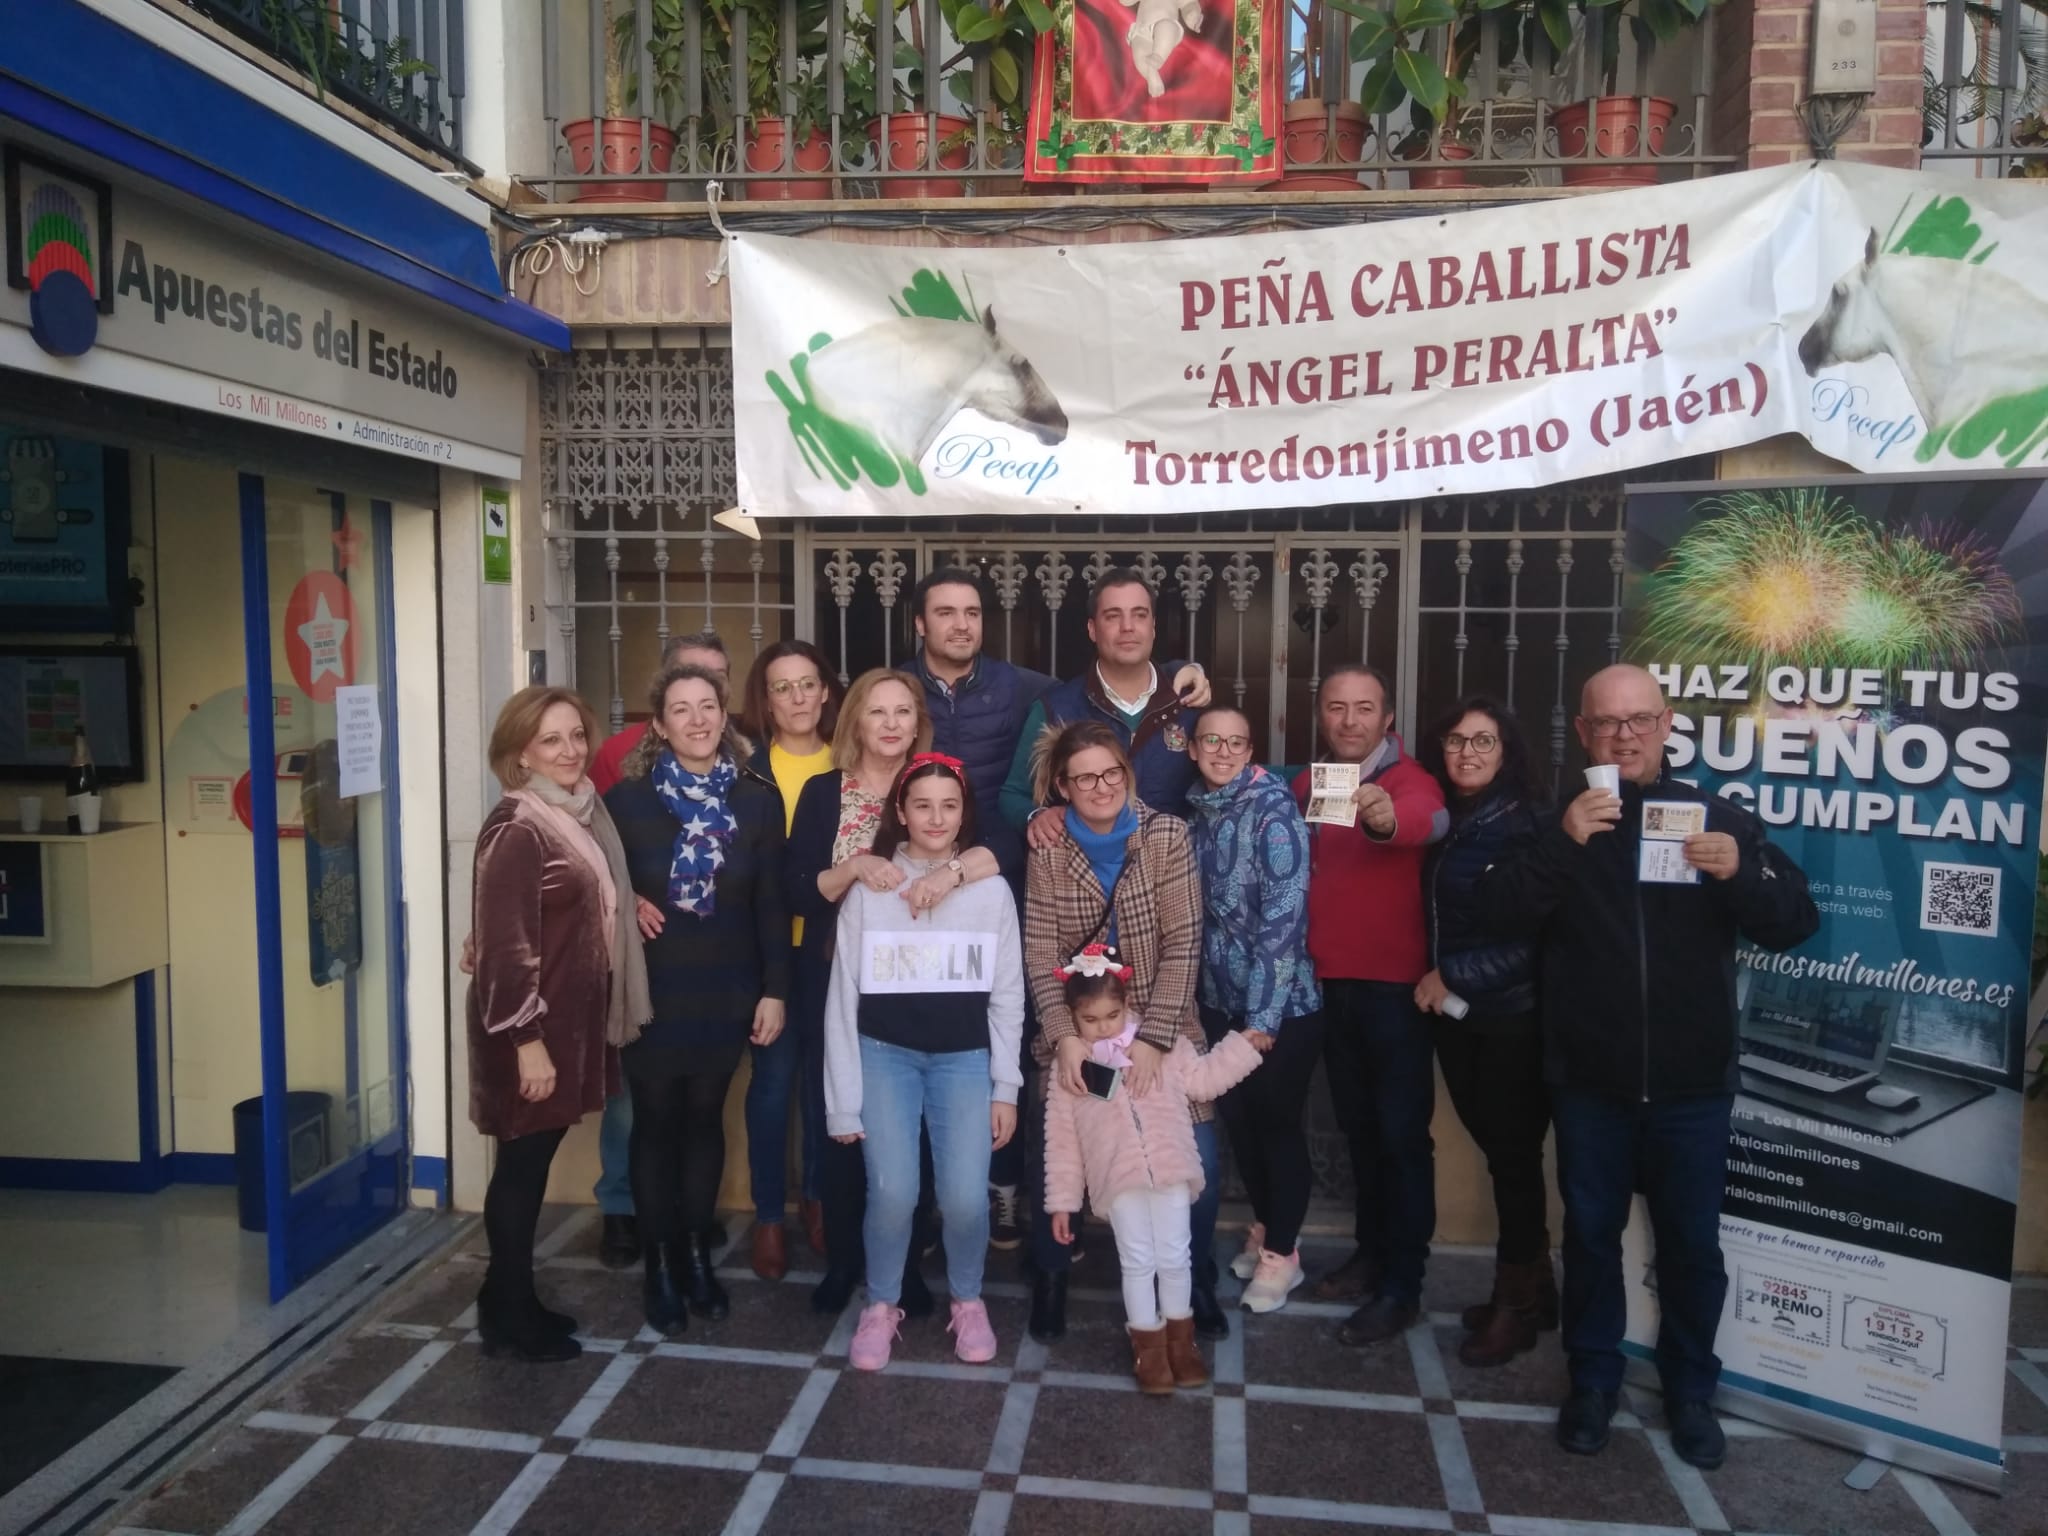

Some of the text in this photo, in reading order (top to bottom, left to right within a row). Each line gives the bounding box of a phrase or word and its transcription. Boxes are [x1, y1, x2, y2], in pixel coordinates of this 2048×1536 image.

[1831, 60, 1857, 71] 233
[1180, 223, 1692, 332] PEÑA CABALLISTA
[118, 239, 458, 399] Apuestas del Estado
[1184, 306, 1678, 408] “ÁNGEL PERALTA”
[218, 386, 243, 411] Los
[249, 394, 271, 418] Mil
[275, 399, 328, 431] Millones
[353, 420, 430, 456] Administración
[446, 444, 453, 461] 2
[1125, 361, 1768, 486] Torredonjimeno (Jaén)
[1812, 379, 1916, 459] Pecap
[934, 434, 1060, 495] Pecap
[1648, 663, 2020, 712] HAZ QUE TUS
[1664, 707, 2011, 789] SUEÑOS
[1807, 879, 1894, 902] ién a través
[1852, 904, 1888, 920] web.
[1730, 1105, 1755, 1123] ria
[1796, 1116, 1821, 1136] Mil
[1729, 1133, 1861, 1172] rialosmilmillones
[1724, 1185, 1944, 1245] rialosmilmillones@gmail.com
[1756, 1228, 1779, 1246] que
[1781, 1233, 1821, 1256] hemos
[1824, 1245, 1887, 1272] repartido
[1760, 1292, 1823, 1319] PREMIO
[1762, 1280, 1808, 1301] 92845
[1864, 1316, 1924, 1343] 19152
[1867, 1330, 1900, 1344] VENDIDO
